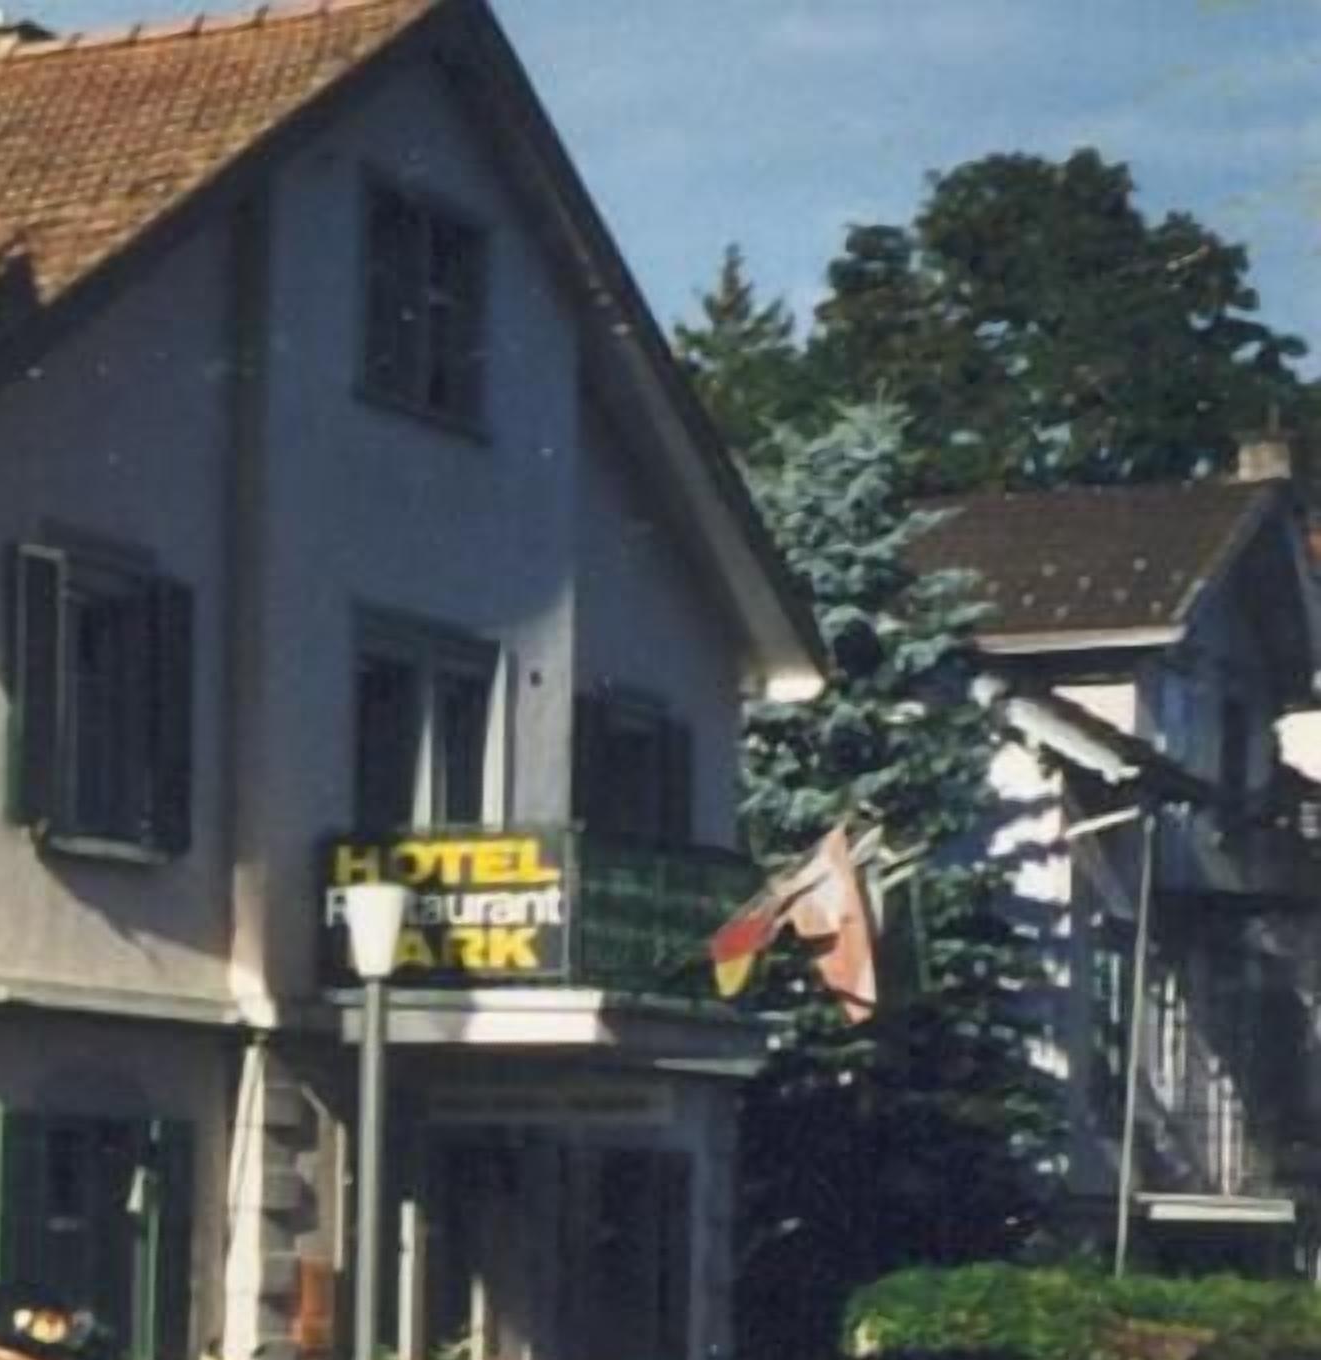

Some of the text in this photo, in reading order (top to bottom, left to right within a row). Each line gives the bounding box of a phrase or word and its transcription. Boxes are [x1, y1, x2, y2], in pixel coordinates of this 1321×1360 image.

[335, 839, 561, 884] HOTEL
[326, 887, 564, 928] Raurant
[393, 927, 539, 969] ARK
